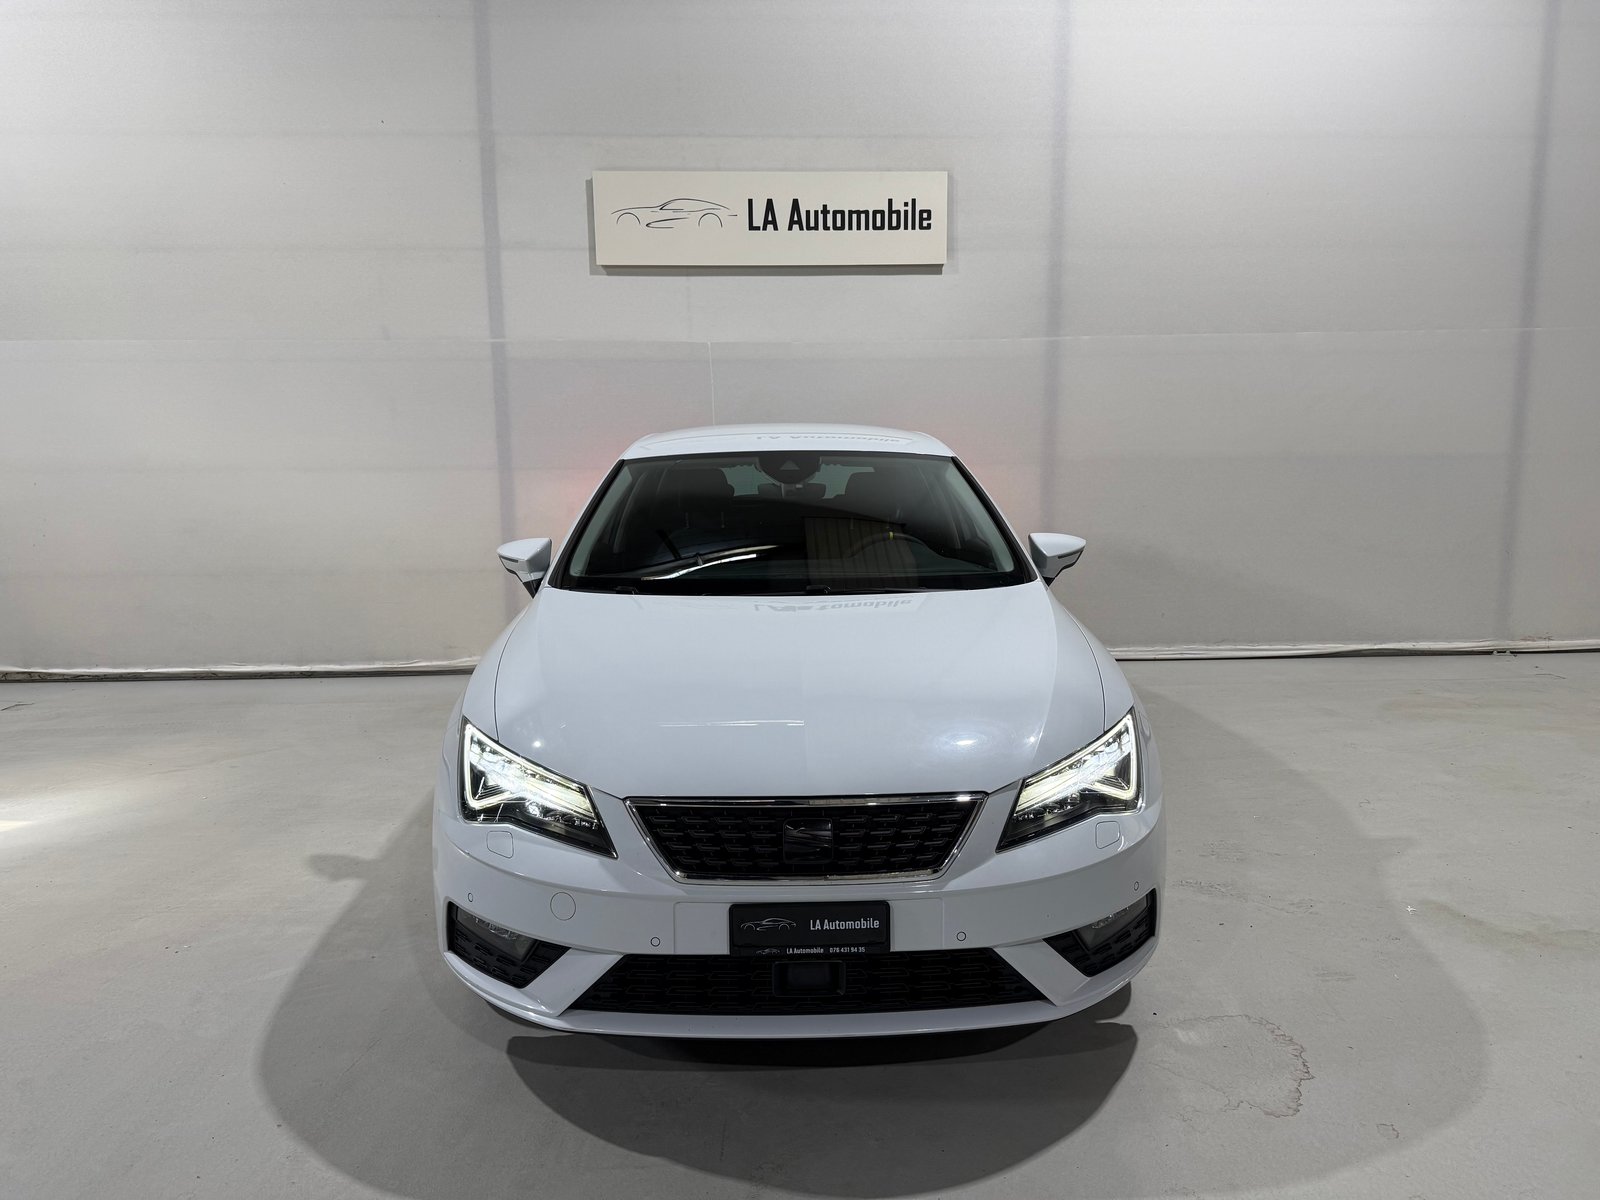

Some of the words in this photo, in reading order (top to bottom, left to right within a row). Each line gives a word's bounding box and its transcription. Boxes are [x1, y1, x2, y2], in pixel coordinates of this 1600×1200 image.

[747, 198, 779, 231] LA
[787, 198, 932, 231] Automobile
[810, 919, 822, 930] LA
[823, 917, 880, 930] Automobile
[786, 947, 794, 955] LA
[794, 946, 825, 955] Automobile
